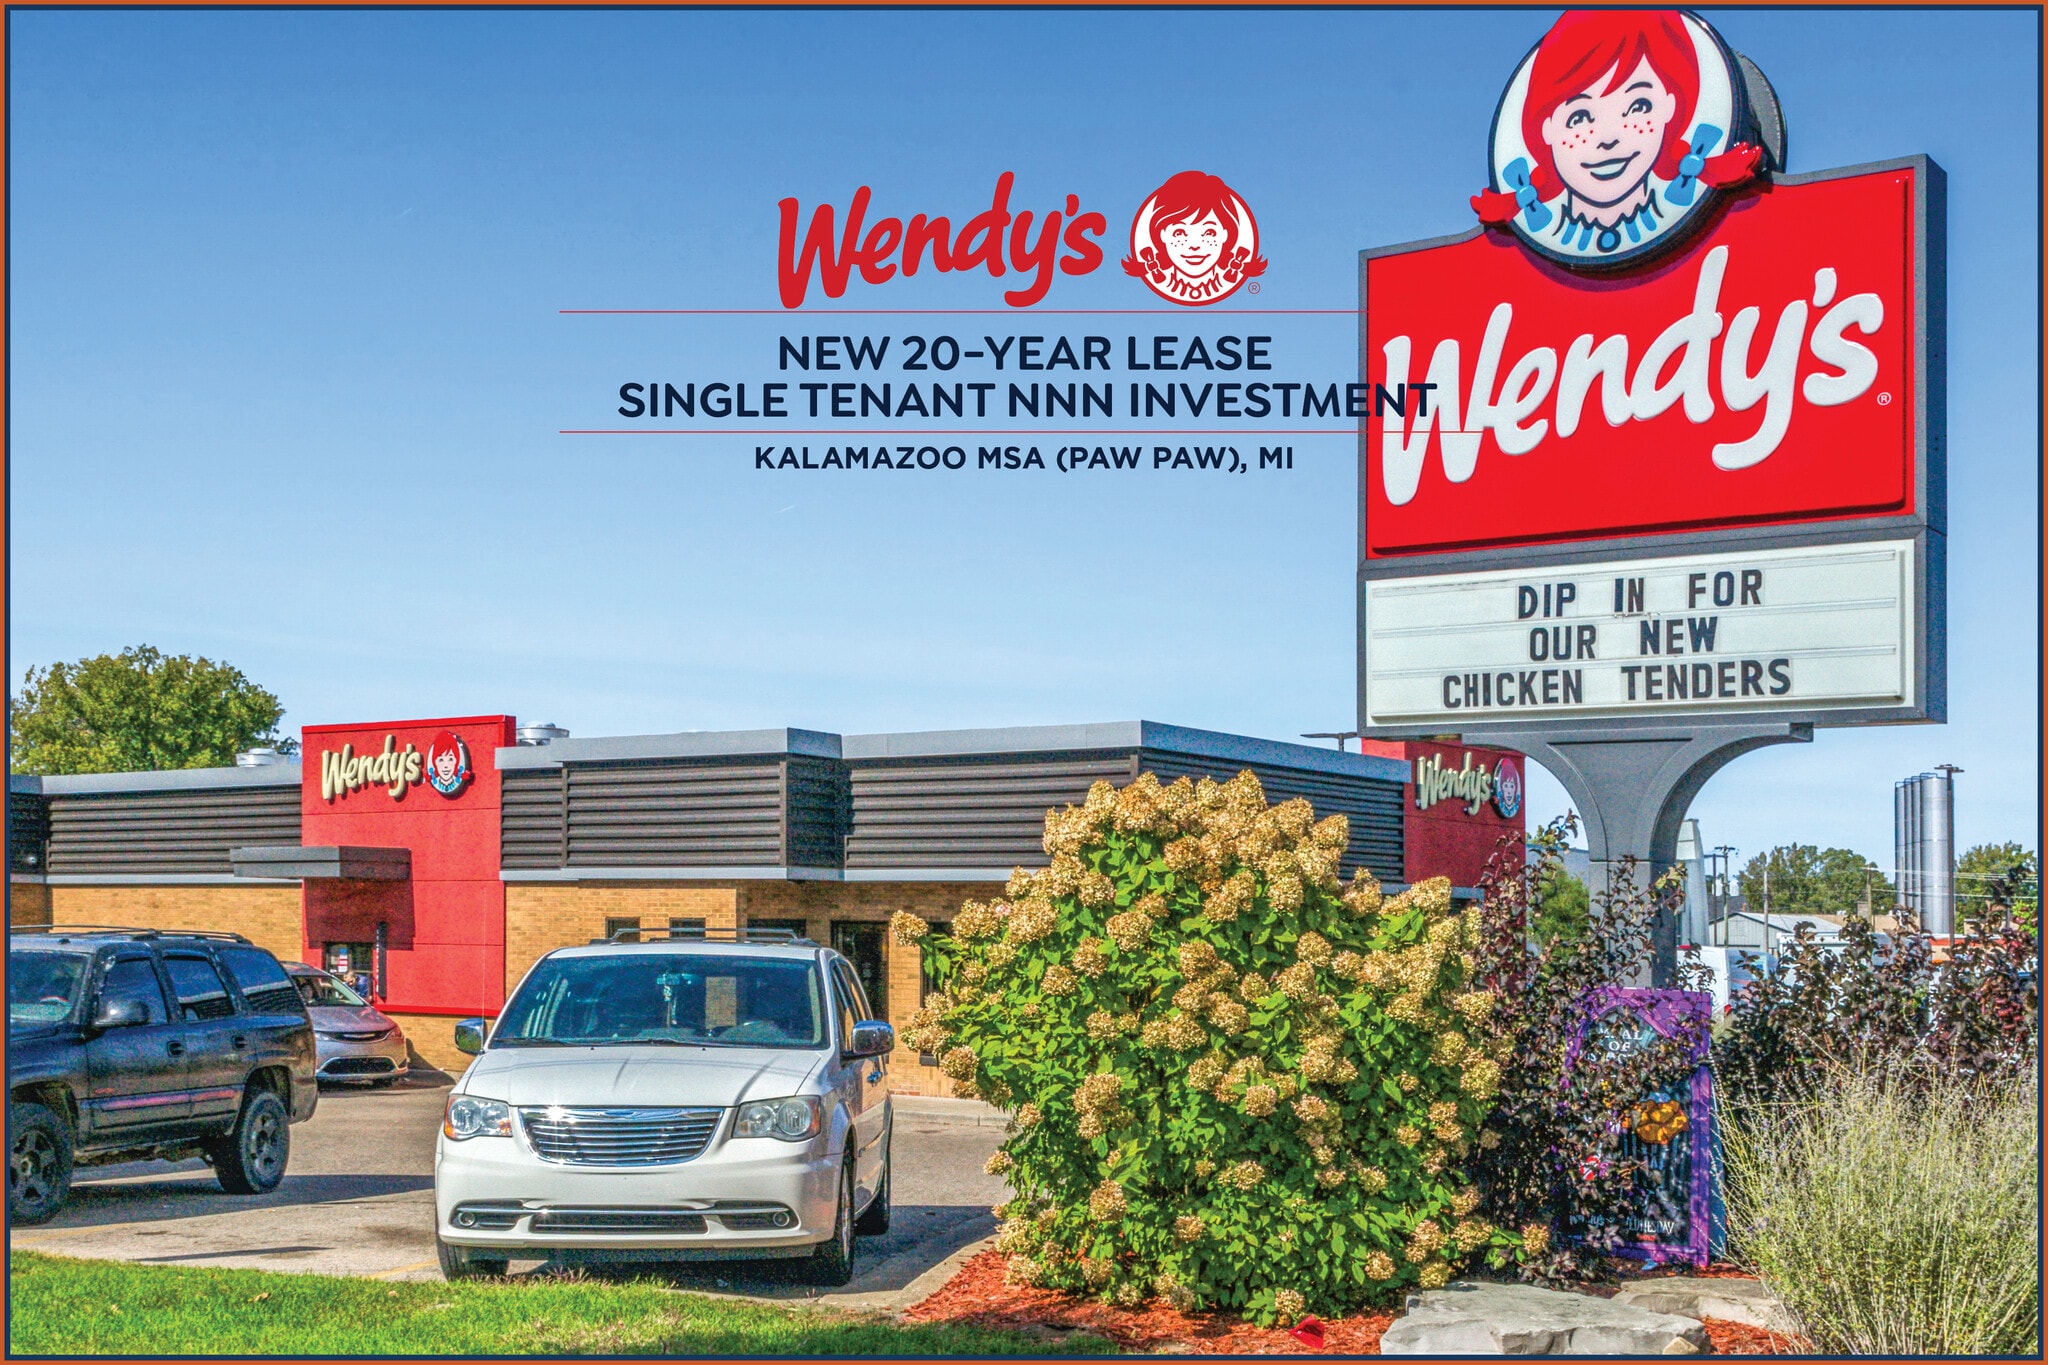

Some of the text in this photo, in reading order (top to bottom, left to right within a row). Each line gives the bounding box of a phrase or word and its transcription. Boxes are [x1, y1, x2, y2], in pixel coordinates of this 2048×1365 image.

[1383, 245, 1884, 506] Wendy's
[1518, 569, 1763, 619] DIP IN FOR
[1529, 616, 1718, 661] OUR NEW
[1443, 658, 1791, 709] CHICKEN TENDERS
[322, 734, 422, 800] Wendy's
[1416, 751, 1491, 815] Wendy's
[1608, 1041, 1632, 1052] OF
